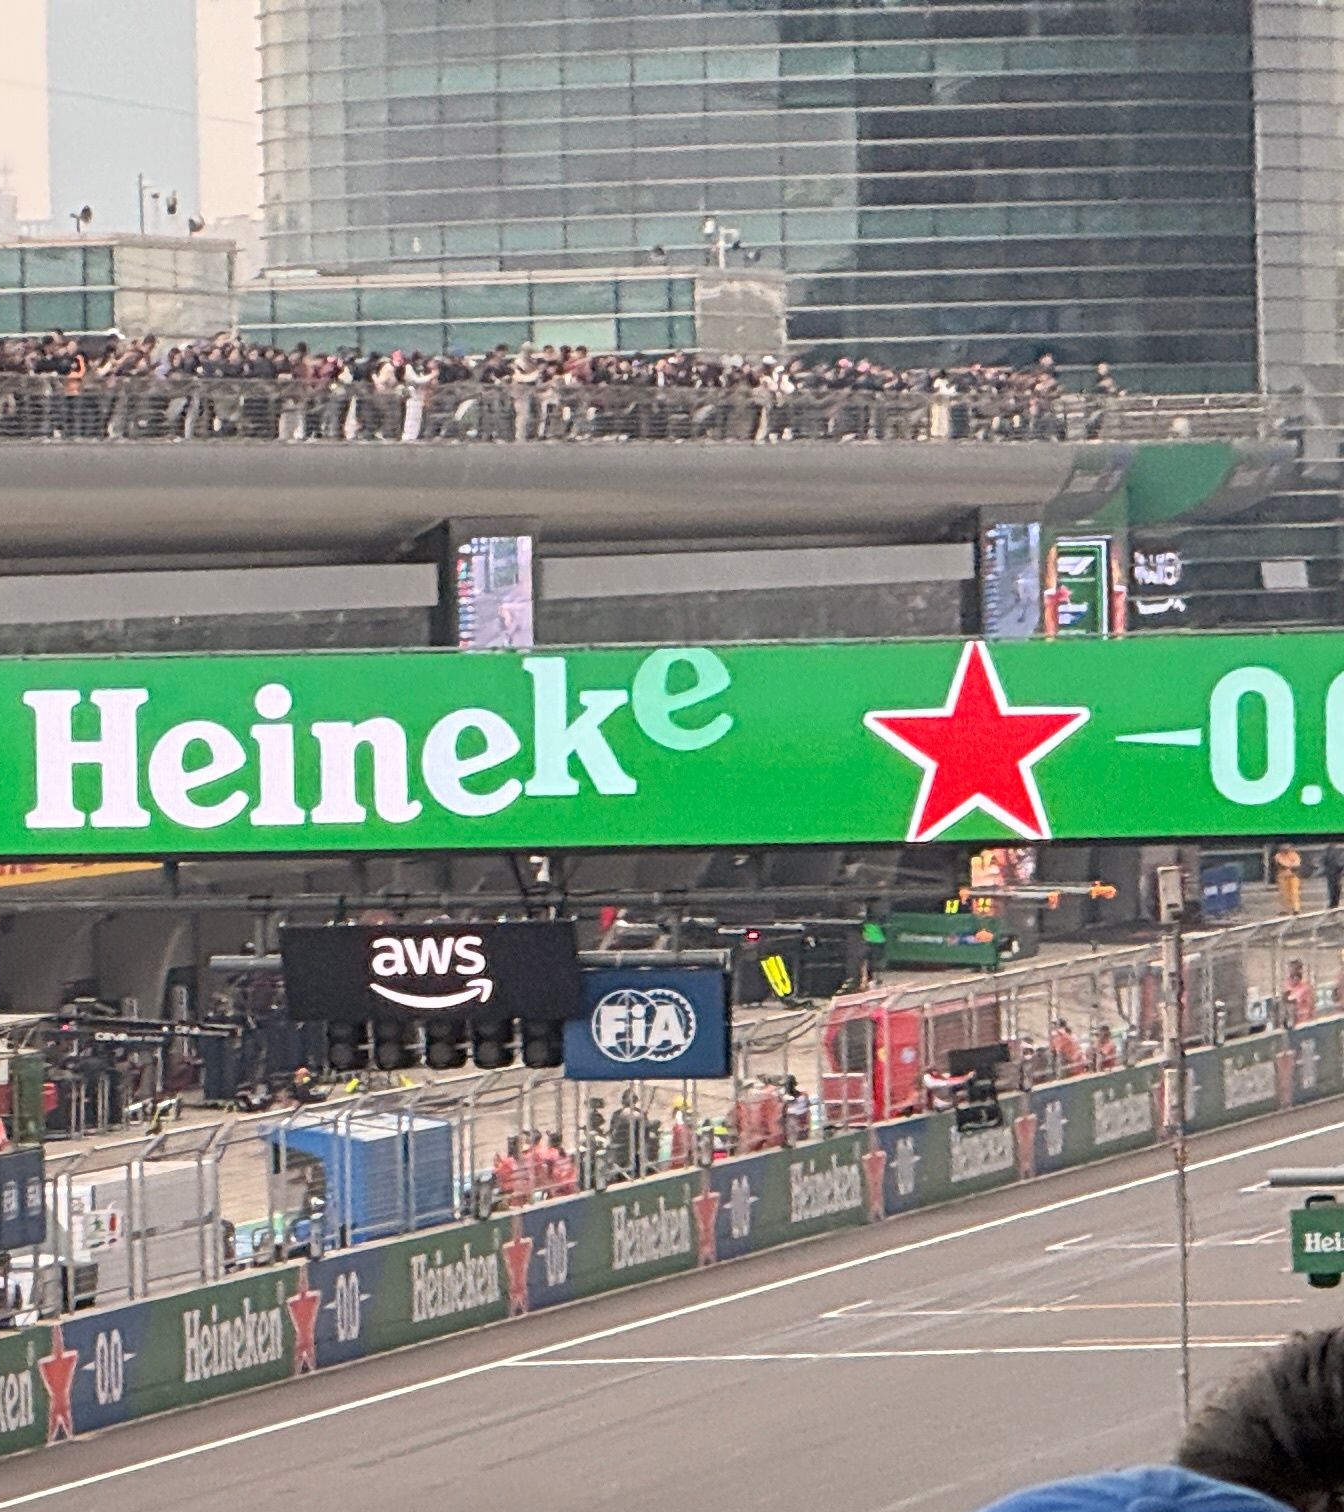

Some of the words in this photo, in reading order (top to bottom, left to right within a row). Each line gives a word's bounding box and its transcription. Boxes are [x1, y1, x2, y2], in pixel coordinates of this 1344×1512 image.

[1210, 666, 1344, 805] 0.
[370, 935, 487, 978] aws
[1304, 1231, 1344, 1253] Hei
